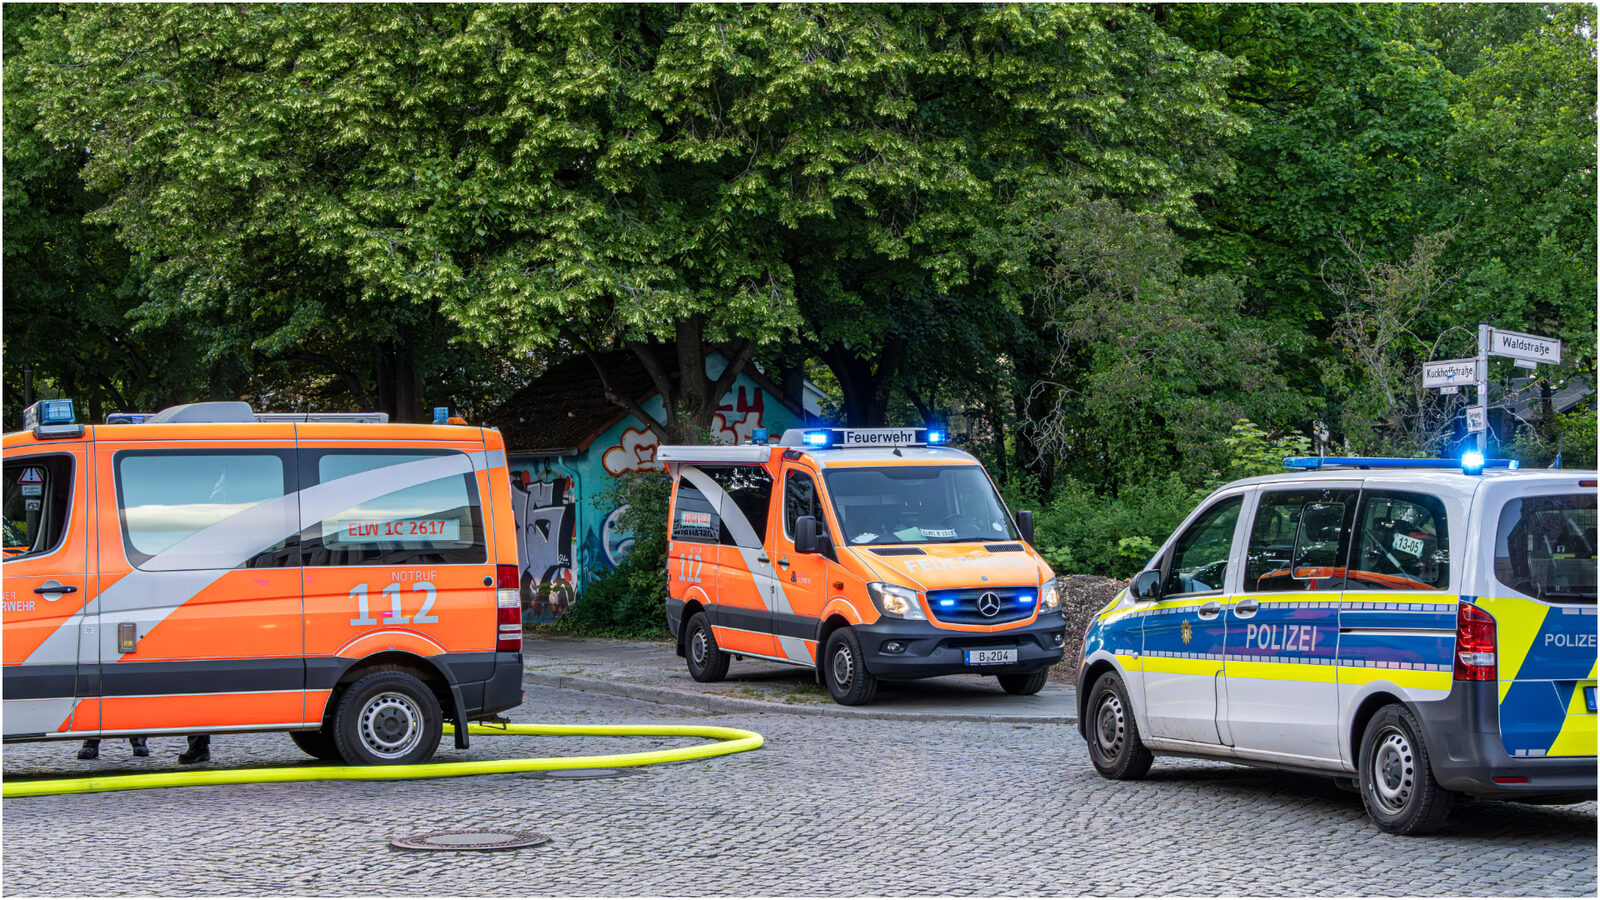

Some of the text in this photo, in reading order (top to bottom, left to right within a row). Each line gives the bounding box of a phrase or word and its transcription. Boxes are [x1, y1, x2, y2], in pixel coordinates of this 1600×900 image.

[1502, 336, 1550, 356] Waldstraße
[846, 430, 913, 443] Feuerwehr
[348, 520, 446, 537] ELW 1C 2617
[1398, 536, 1419, 553] 13-05
[679, 553, 703, 583] 112
[903, 556, 1031, 573] FEUERWEHR
[391, 570, 437, 582] NOTRUF
[348, 581, 439, 626] 112
[1245, 624, 1317, 651] POLIZEI
[1545, 633, 1597, 648] POLIZE
[990, 650, 1009, 661] 204
